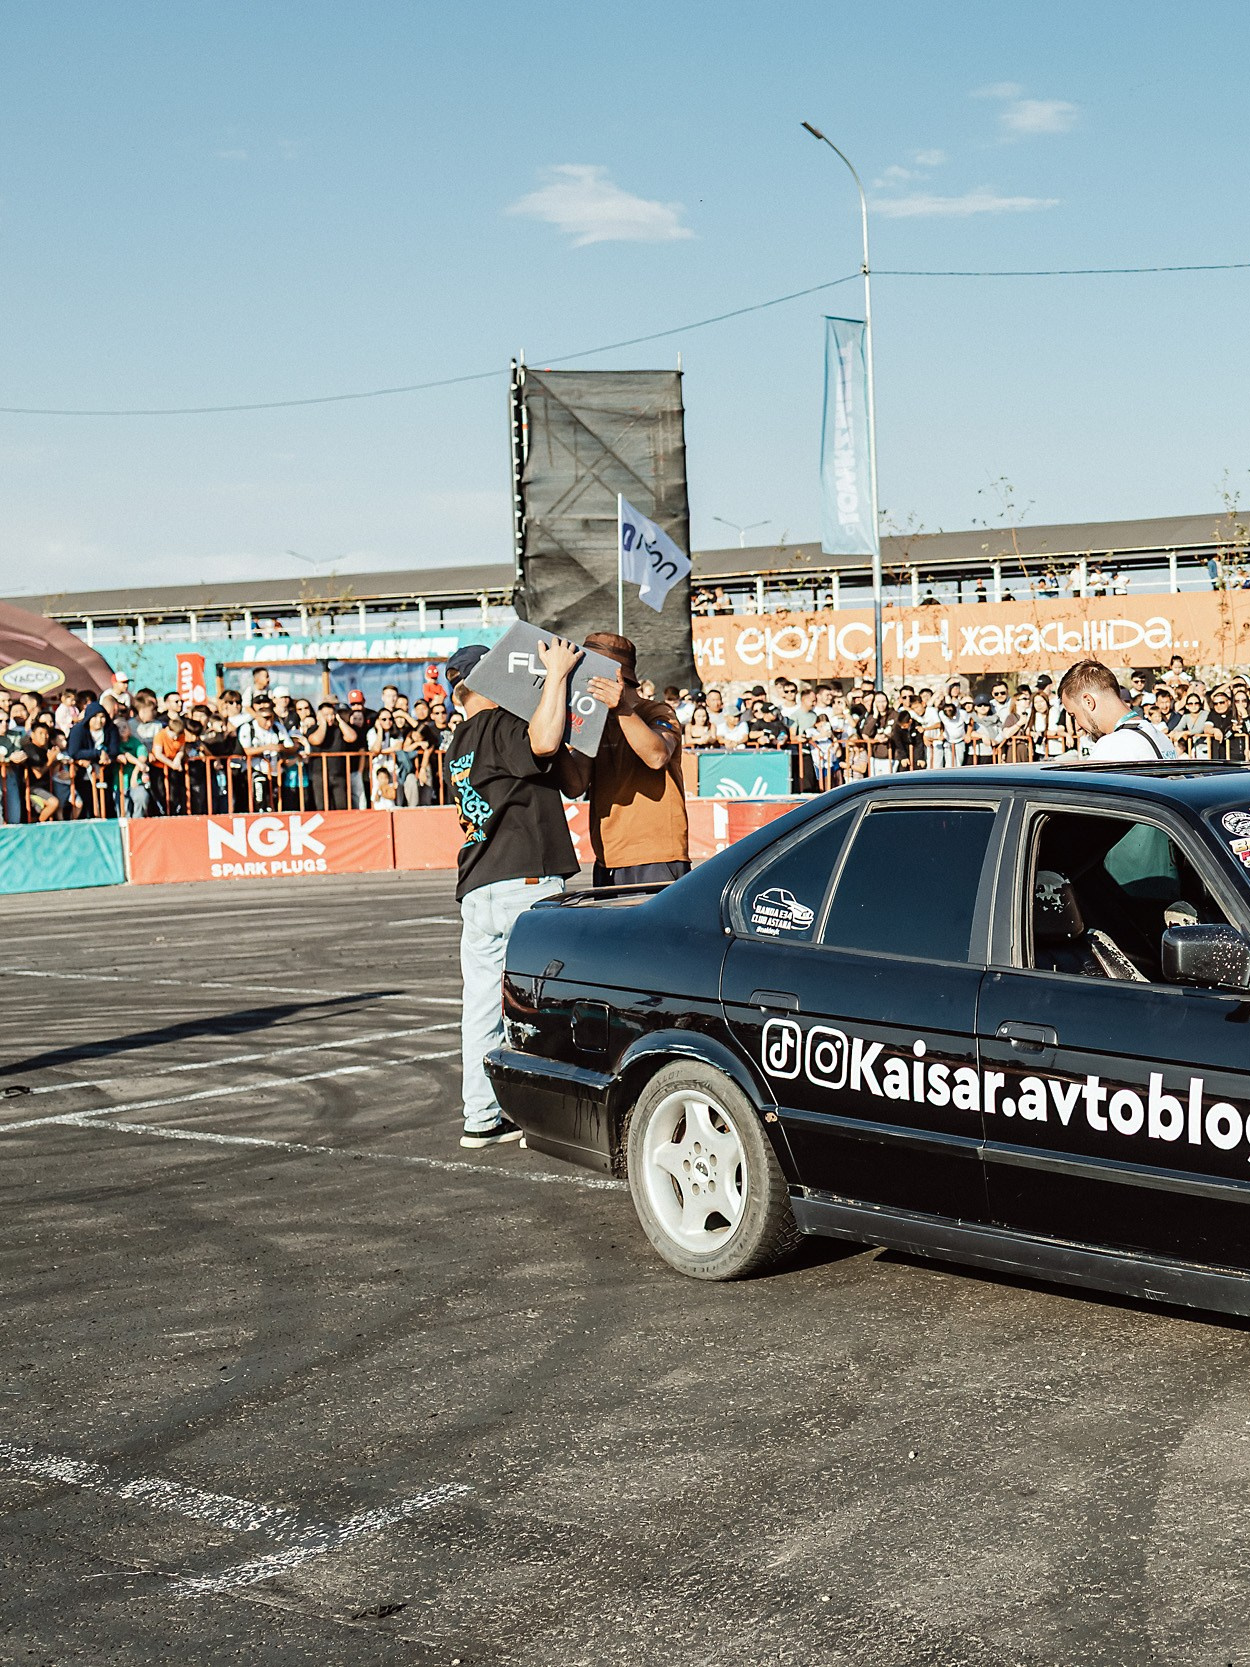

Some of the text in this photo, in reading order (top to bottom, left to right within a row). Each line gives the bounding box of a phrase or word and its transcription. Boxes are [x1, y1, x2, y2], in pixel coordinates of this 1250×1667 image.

[10, 672, 55, 686] YACCO
[207, 813, 326, 860] NGK
[210, 858, 327, 877] SPARK PLUGS
